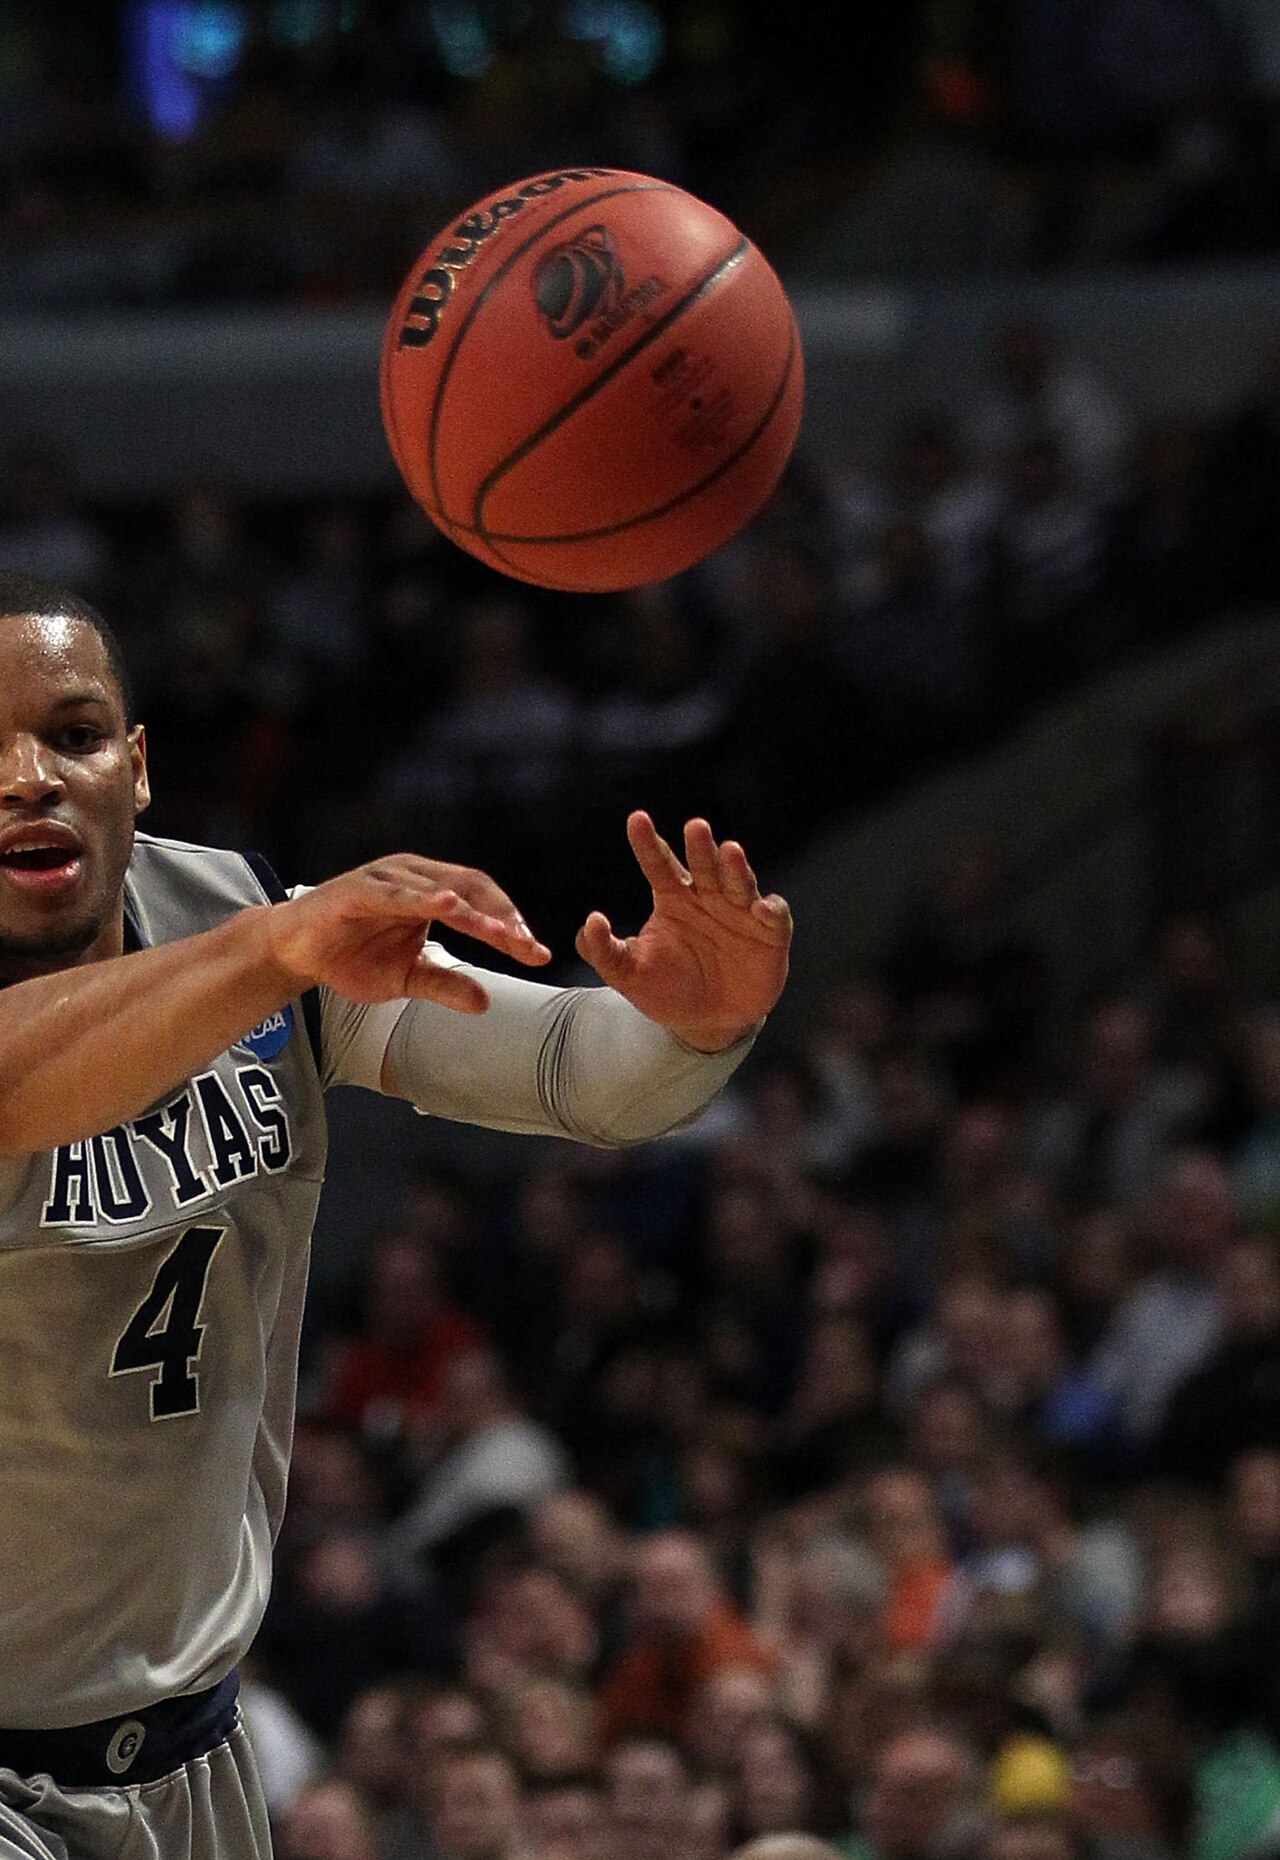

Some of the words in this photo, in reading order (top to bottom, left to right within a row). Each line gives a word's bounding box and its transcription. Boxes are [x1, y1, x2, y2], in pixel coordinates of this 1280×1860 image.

[399, 167, 615, 349] Wilson
[39, 1064, 292, 1228] HOYAS
[107, 1224, 230, 1422] 4
